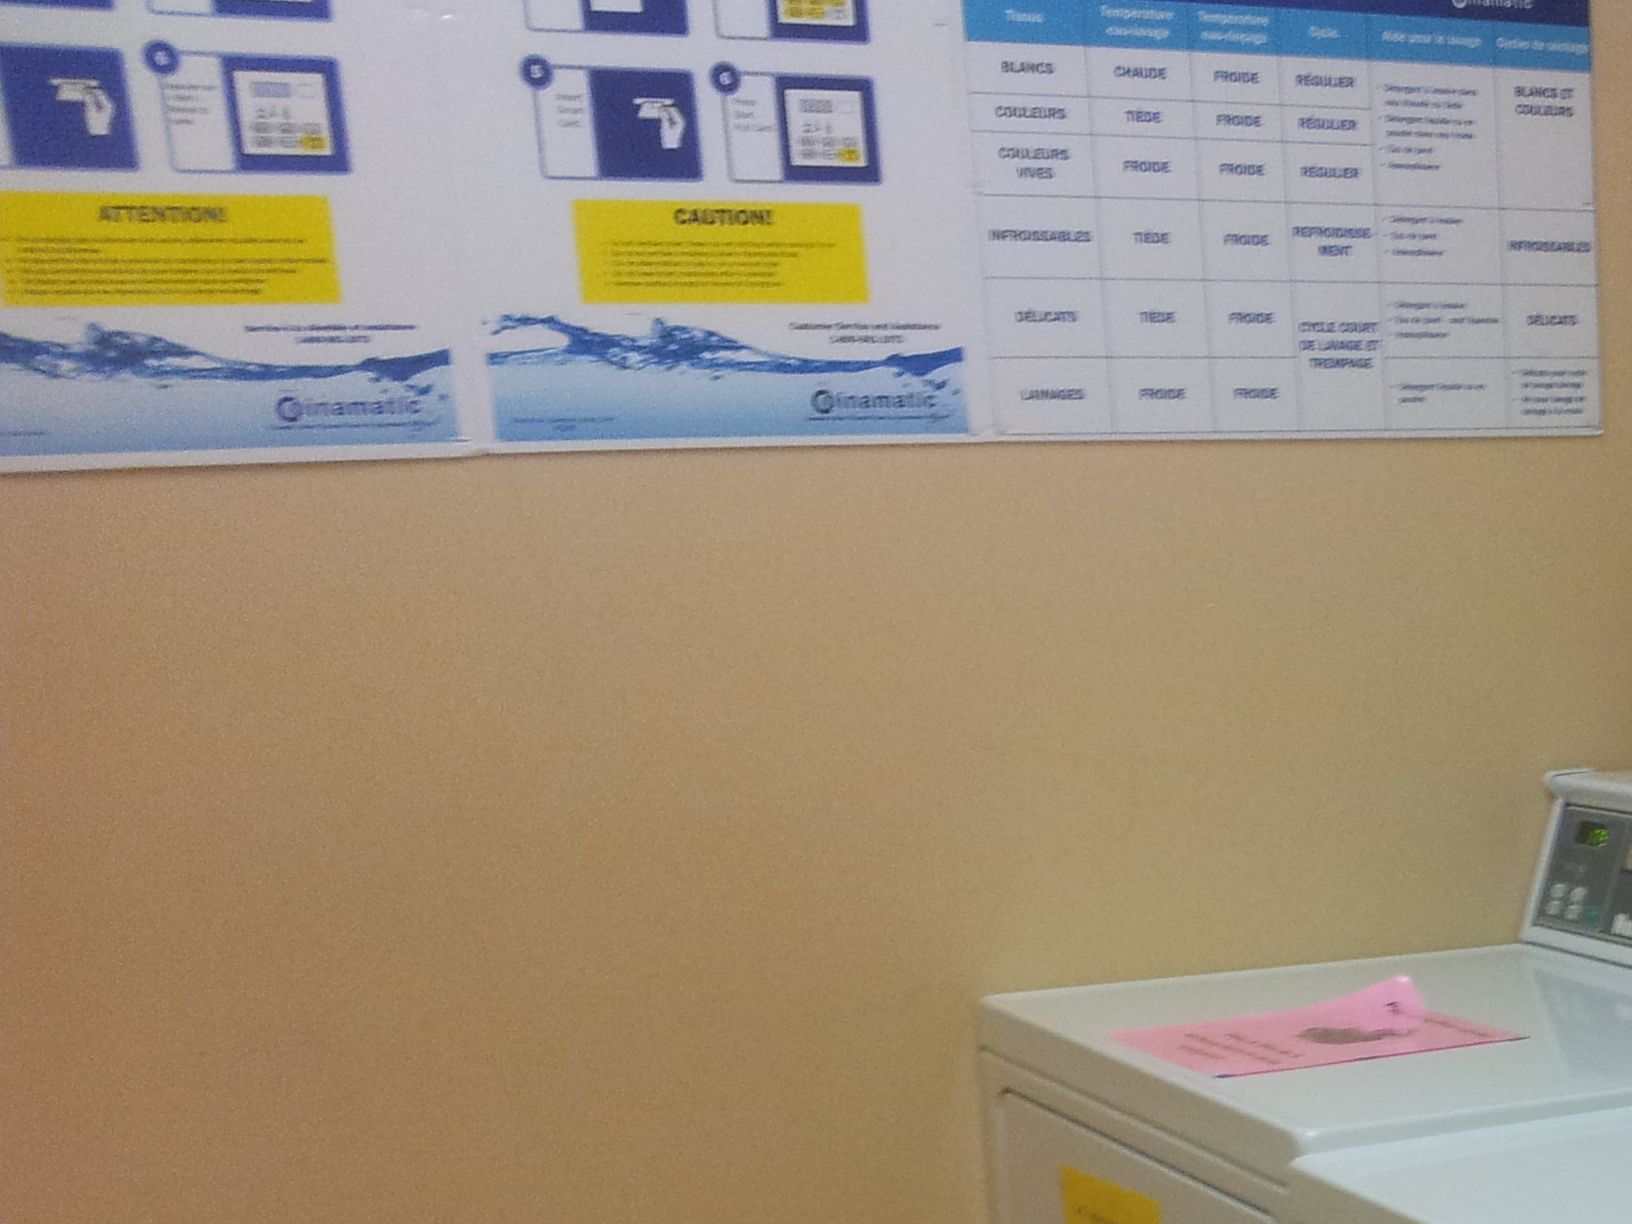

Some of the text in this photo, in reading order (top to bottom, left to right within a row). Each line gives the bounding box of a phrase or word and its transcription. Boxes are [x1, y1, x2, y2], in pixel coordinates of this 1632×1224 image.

[1114, 65, 1168, 80] CHAUDE
[1213, 71, 1260, 85] FROIDE
[1514, 86, 1558, 100] BLANCS
[995, 106, 1067, 120] COULEURS
[1515, 104, 1574, 118] COULEURS
[1216, 114, 1263, 128] FROIDE
[1122, 160, 1171, 174] FROIDE
[1219, 163, 1265, 177] FROIDE
[674, 208, 774, 226] CAUTION!
[1223, 233, 1270, 246] FROIDE
